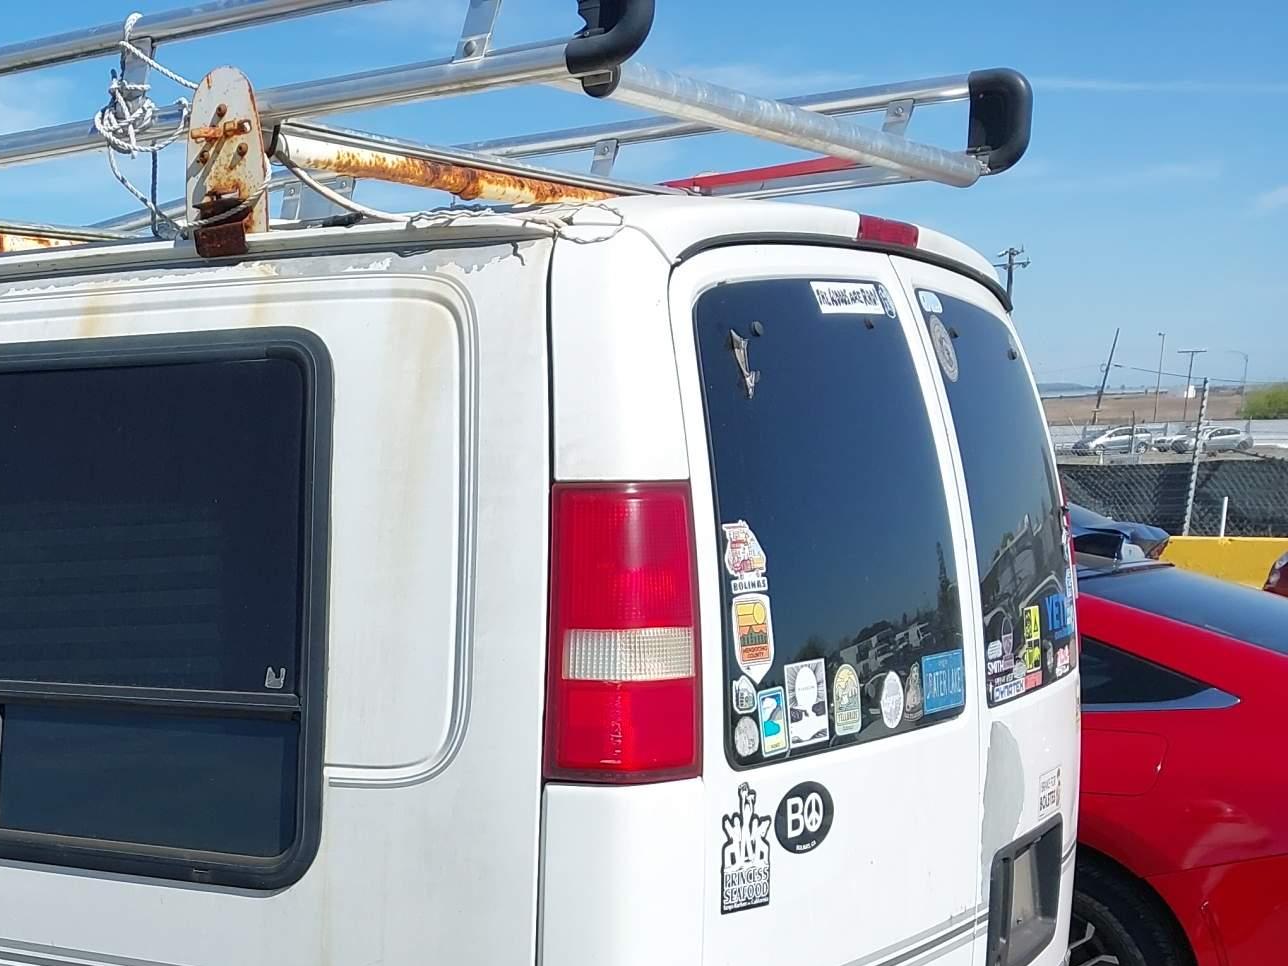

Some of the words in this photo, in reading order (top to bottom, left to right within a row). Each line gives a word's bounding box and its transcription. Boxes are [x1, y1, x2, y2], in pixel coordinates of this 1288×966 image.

[732, 579, 767, 592] BOLINAS
[786, 792, 824, 839] BO
[724, 866, 769, 888] PRINCESS
[723, 882, 769, 905] SEAFOOD
